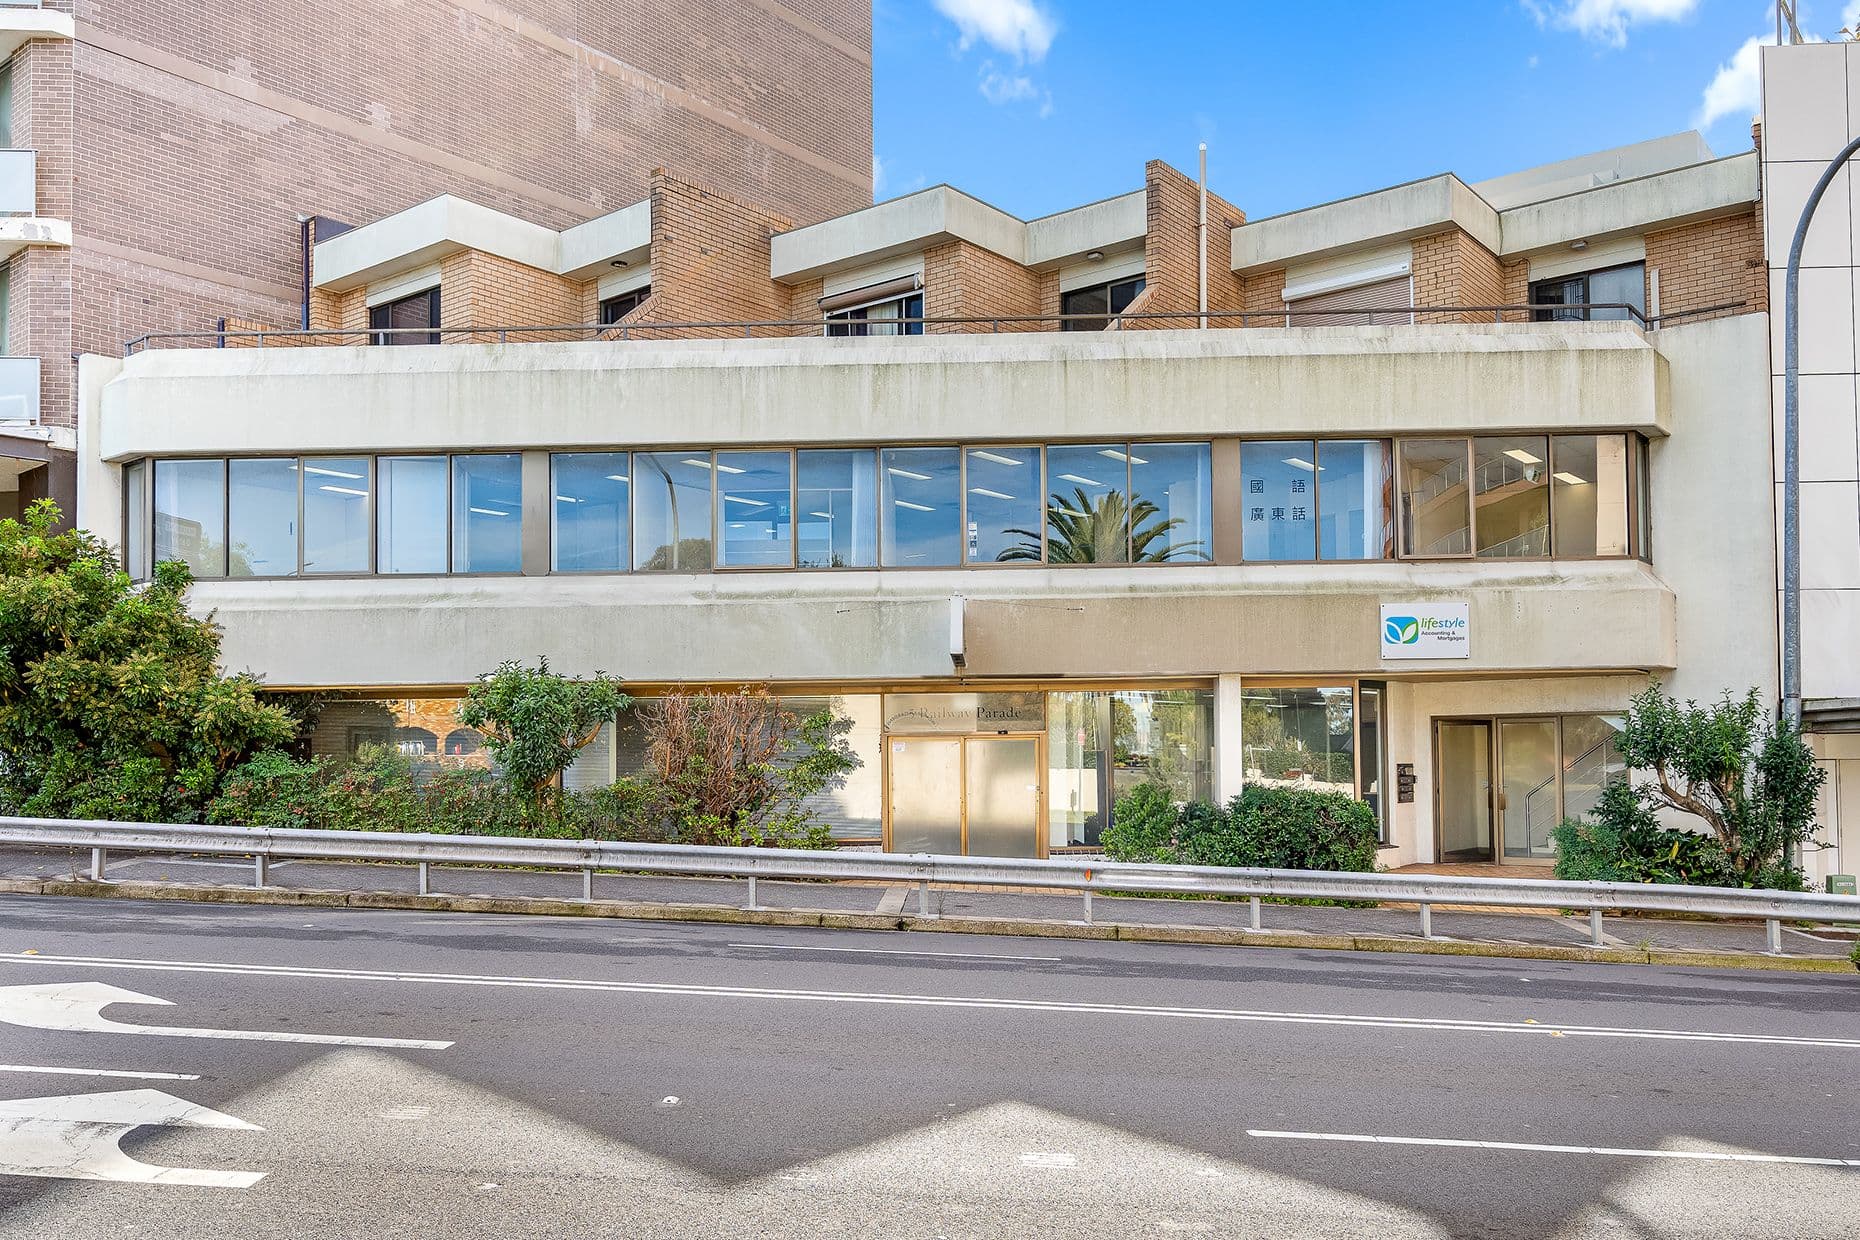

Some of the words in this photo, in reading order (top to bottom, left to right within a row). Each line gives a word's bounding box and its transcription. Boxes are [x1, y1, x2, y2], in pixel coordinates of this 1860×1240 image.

[1250, 506, 1306, 521] 廣東話
[1421, 617, 1465, 630] lifestyle
[919, 706, 973, 719] Railway
[976, 706, 1021, 719] Parade
